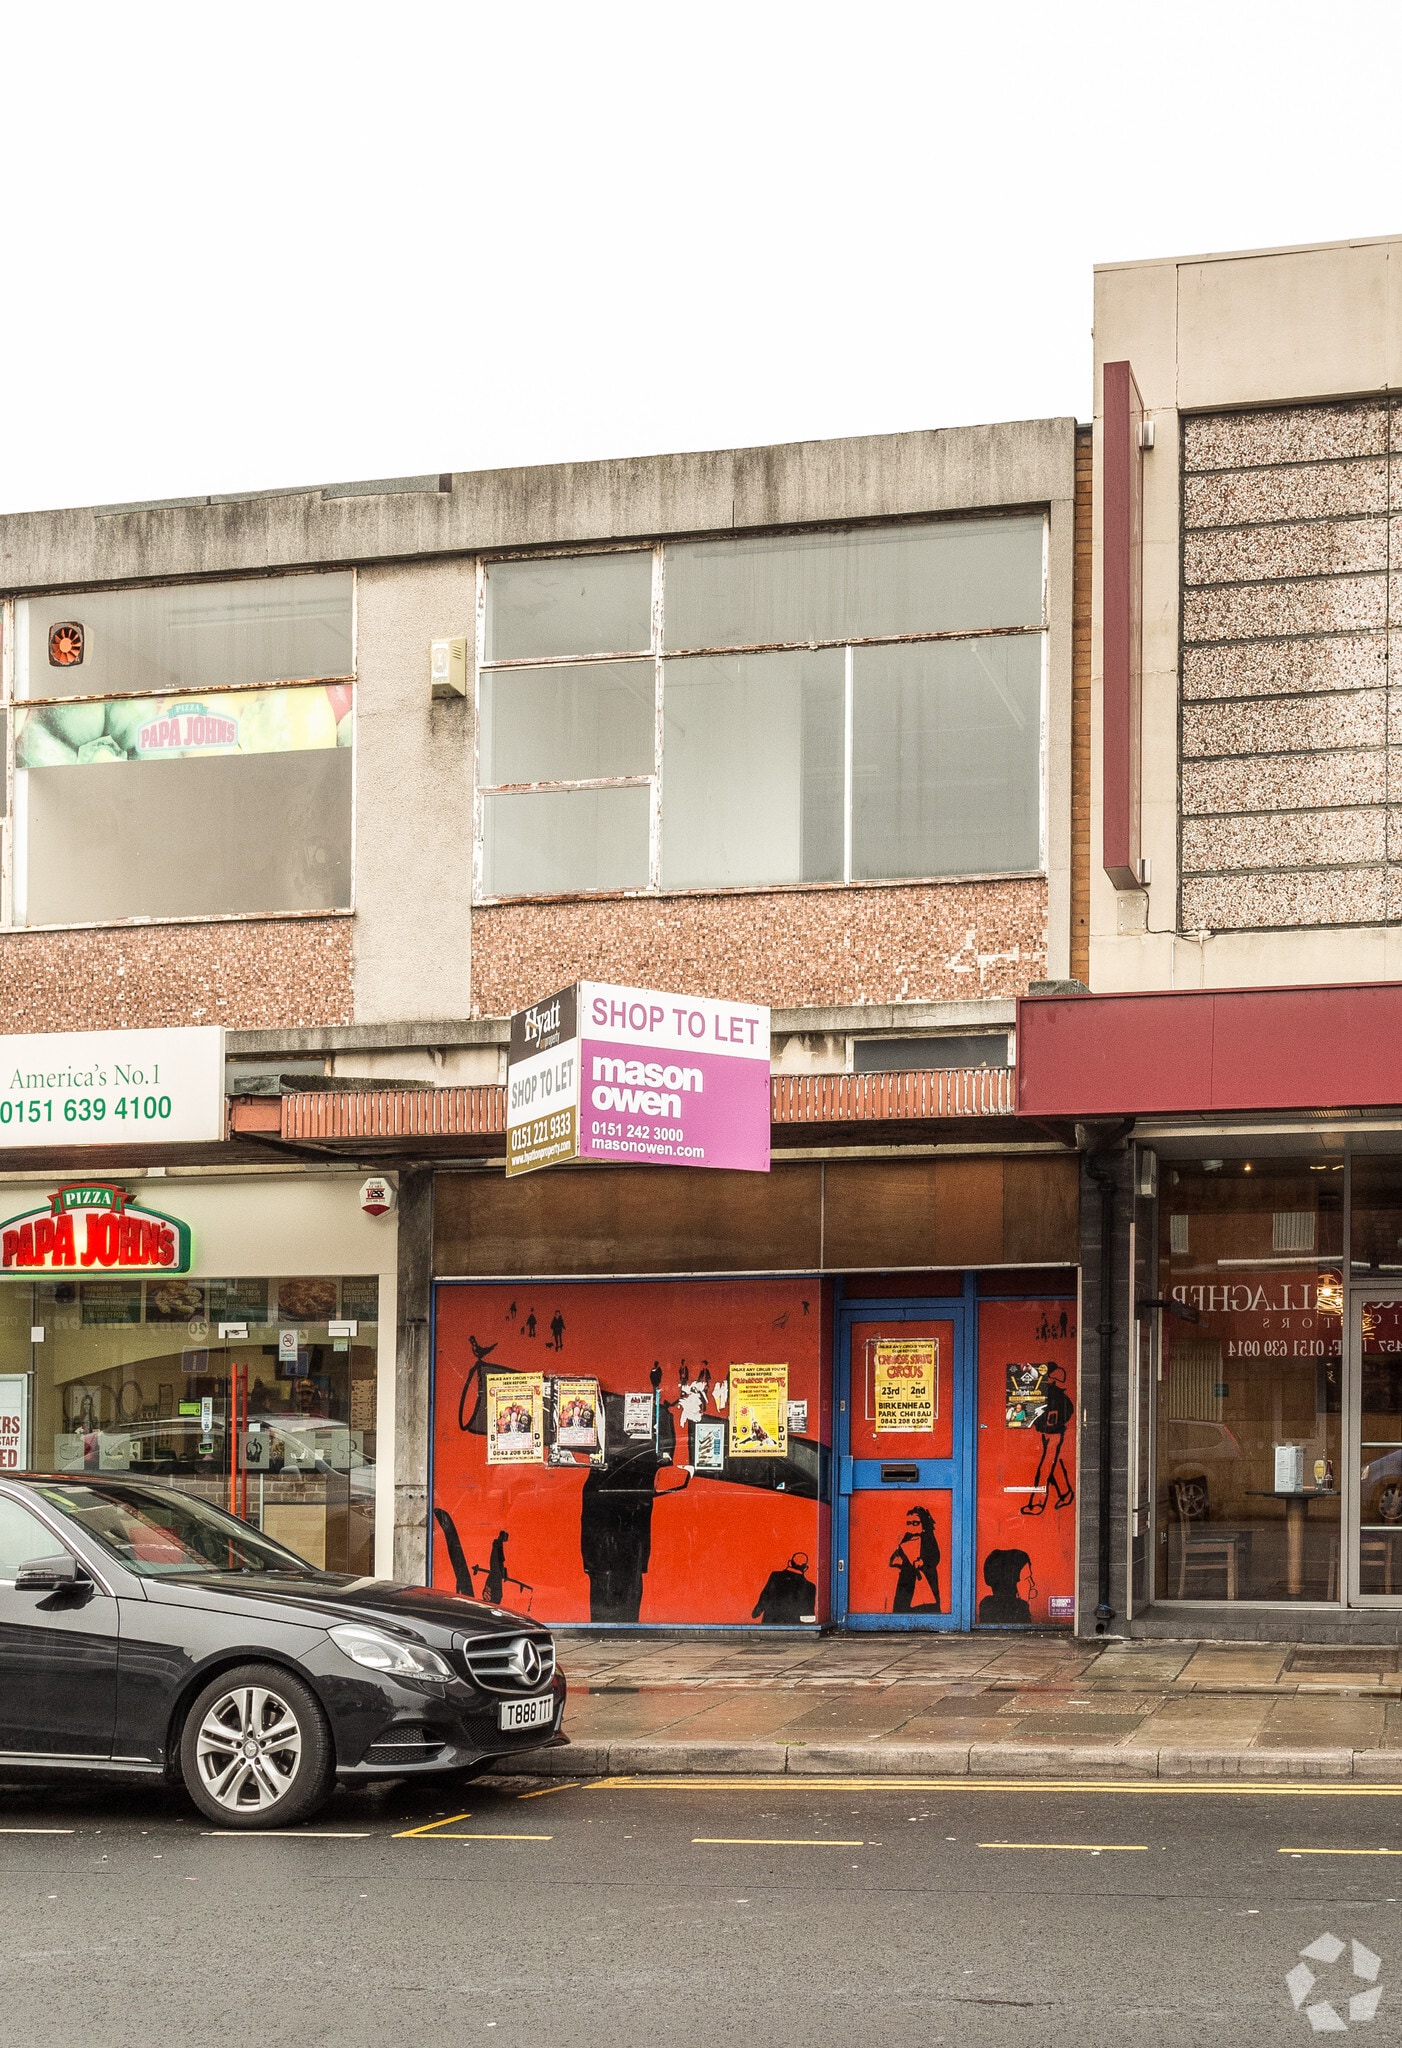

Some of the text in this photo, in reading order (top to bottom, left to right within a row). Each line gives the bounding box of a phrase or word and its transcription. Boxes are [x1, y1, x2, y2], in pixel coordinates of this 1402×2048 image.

[175, 703, 200, 712] PIZZA
[141, 718, 181, 748] PAPA
[524, 999, 561, 1049] Hyatt
[592, 997, 759, 1044] SHOP TO LET
[8, 1064, 161, 1090] America's No.1
[511, 1058, 574, 1110] SHOP TO LET
[592, 1056, 704, 1093] mason
[0, 1095, 172, 1124] 0151 639 4100
[591, 1085, 682, 1119] owen
[511, 1111, 571, 1152] 0151 221 9333
[592, 1121, 684, 1143] 0151 242 3000
[592, 1137, 705, 1159] masonowen.com
[65, 1191, 112, 1206] PIZZA
[3, 1213, 175, 1268] PAPA JOHN'S
[887, 1365, 924, 1379] CIRCUS
[881, 1387, 900, 1395] 23rd
[910, 1386, 926, 1395] 2nd
[0, 1415, 20, 1434] RS
[507, 1698, 551, 1725] T888 TTT
